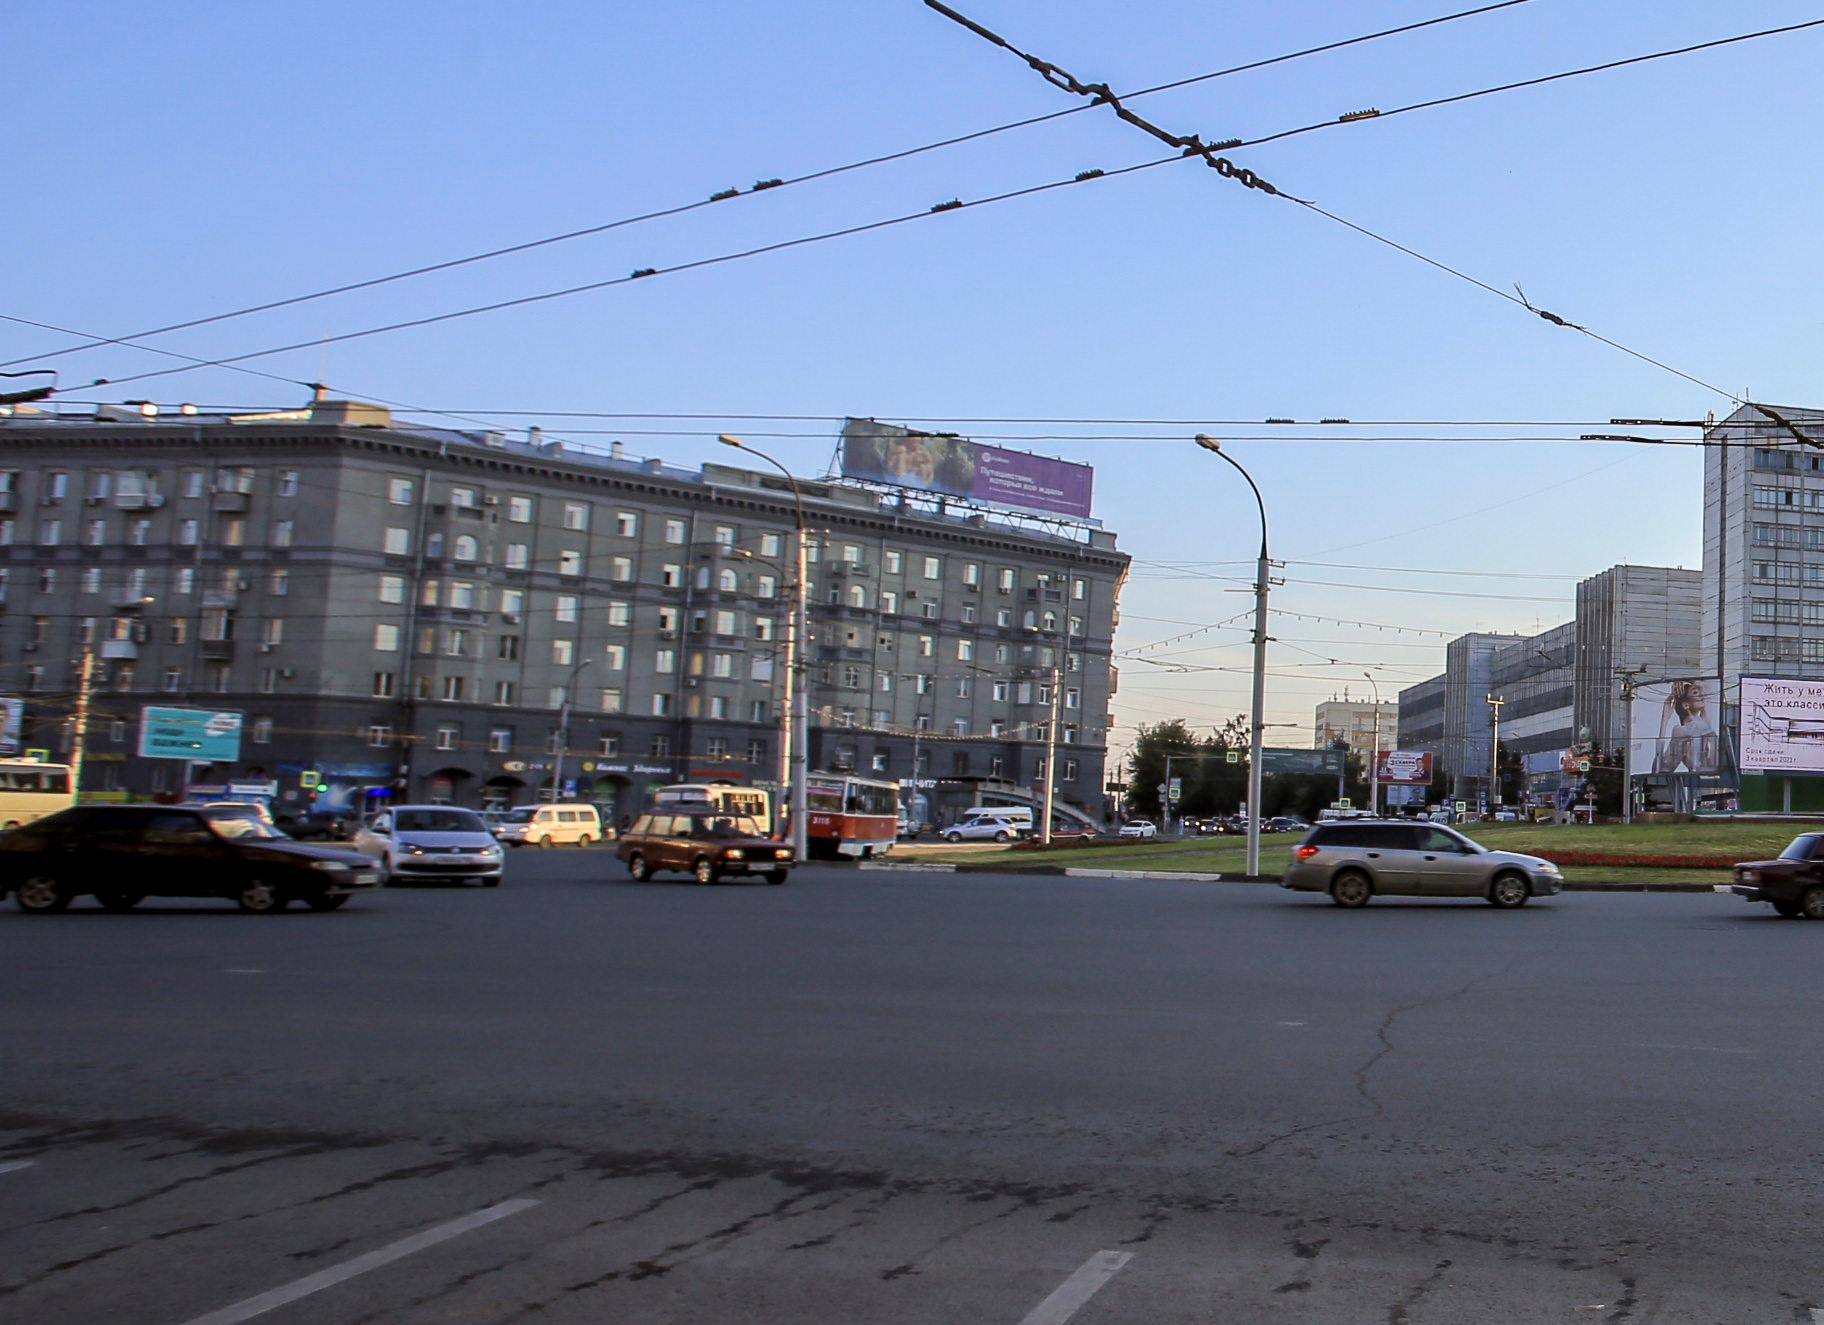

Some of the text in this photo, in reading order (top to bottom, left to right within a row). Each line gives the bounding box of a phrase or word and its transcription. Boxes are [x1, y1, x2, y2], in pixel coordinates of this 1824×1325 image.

[1763, 683, 1794, 695] Жить
[1798, 688, 1804, 698] у
[1763, 699, 1783, 708] это
